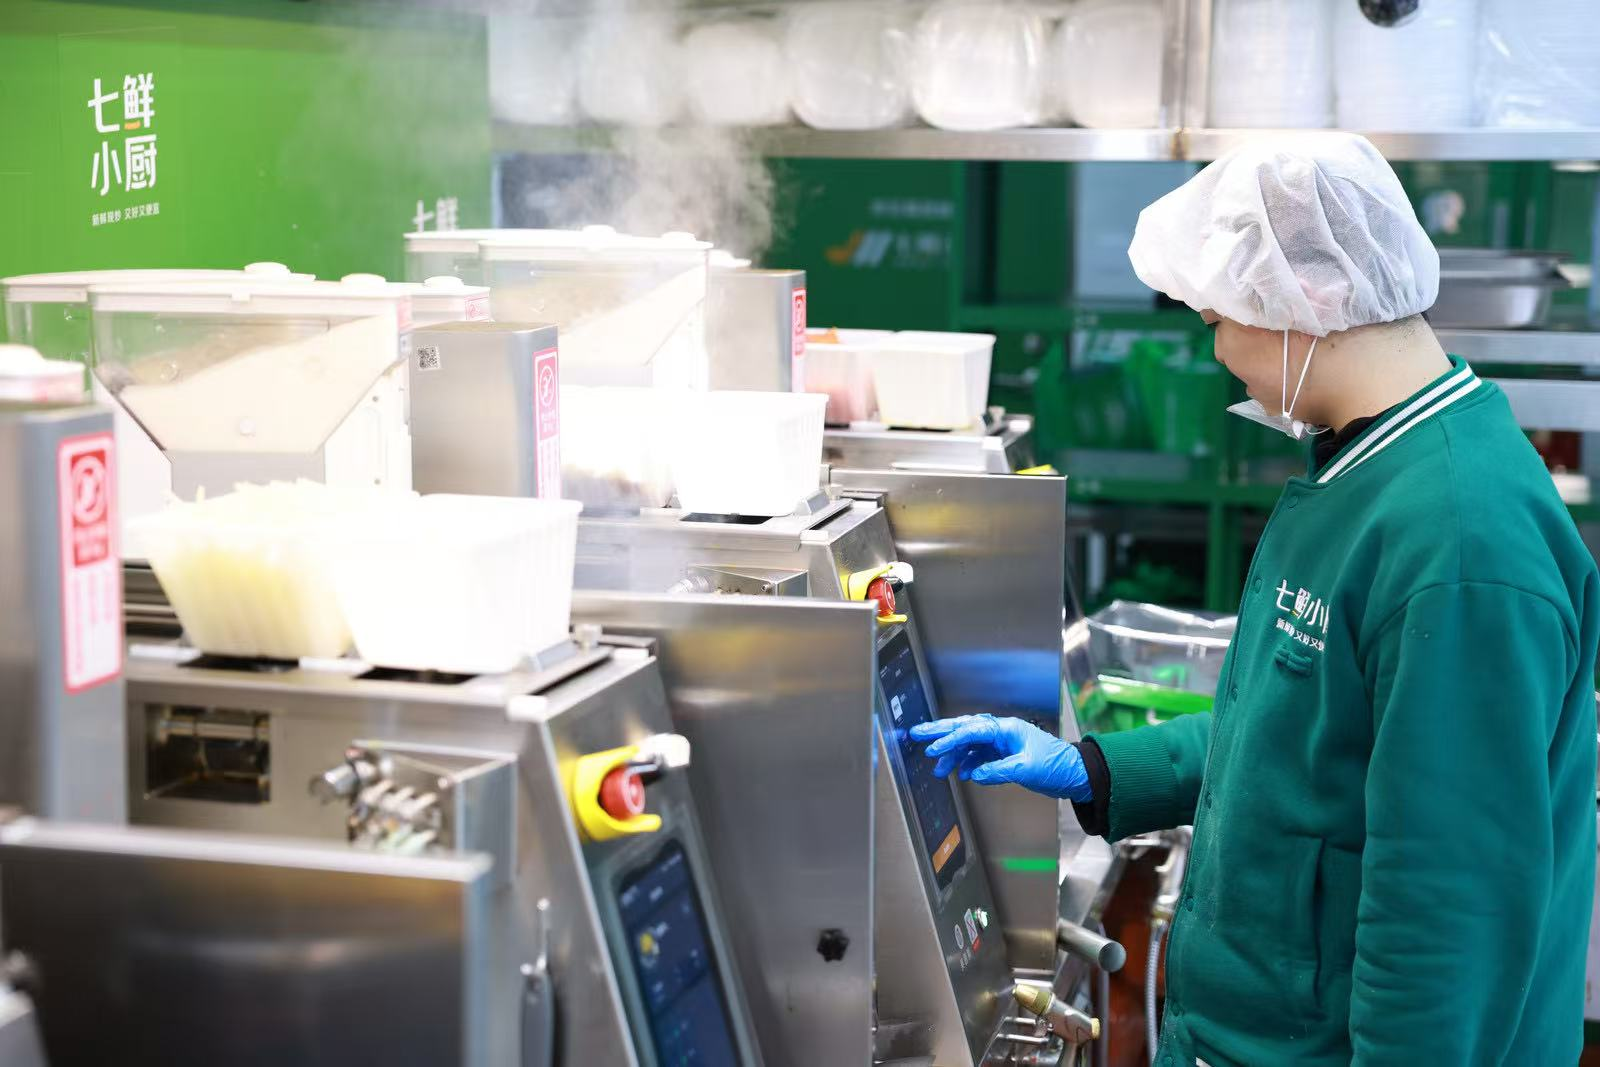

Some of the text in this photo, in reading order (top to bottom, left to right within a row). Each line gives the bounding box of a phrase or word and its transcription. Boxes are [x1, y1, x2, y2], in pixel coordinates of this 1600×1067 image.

[87, 72, 155, 133] 七鲜
[91, 134, 158, 196] 小厨
[1275, 579, 1329, 634] 七鲜小
